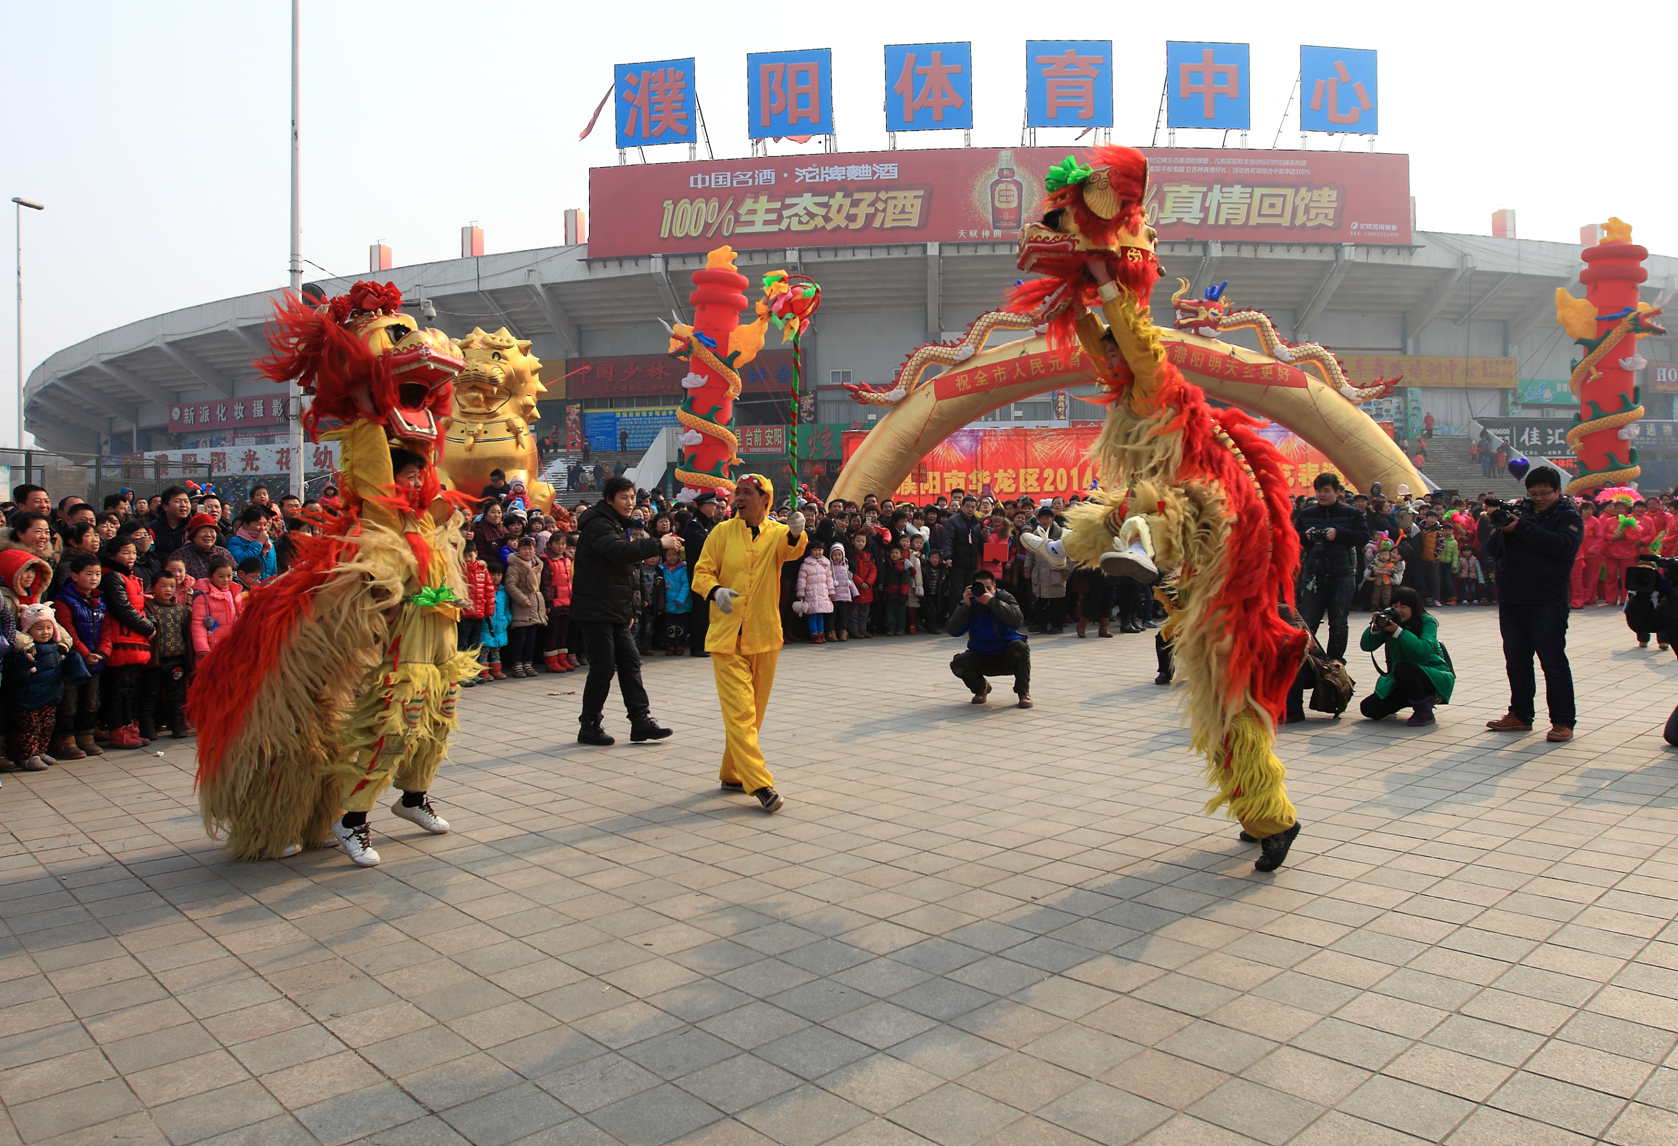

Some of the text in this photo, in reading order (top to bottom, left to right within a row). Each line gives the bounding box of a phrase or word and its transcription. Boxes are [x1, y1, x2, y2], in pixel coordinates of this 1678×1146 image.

[623, 48, 1371, 138] 濮阳体育中心
[660, 190, 924, 238] 100%生态好酒
[1520, 427, 1565, 446] 佳汇
[896, 467, 1103, 496] 濮阳市华龙区2014
